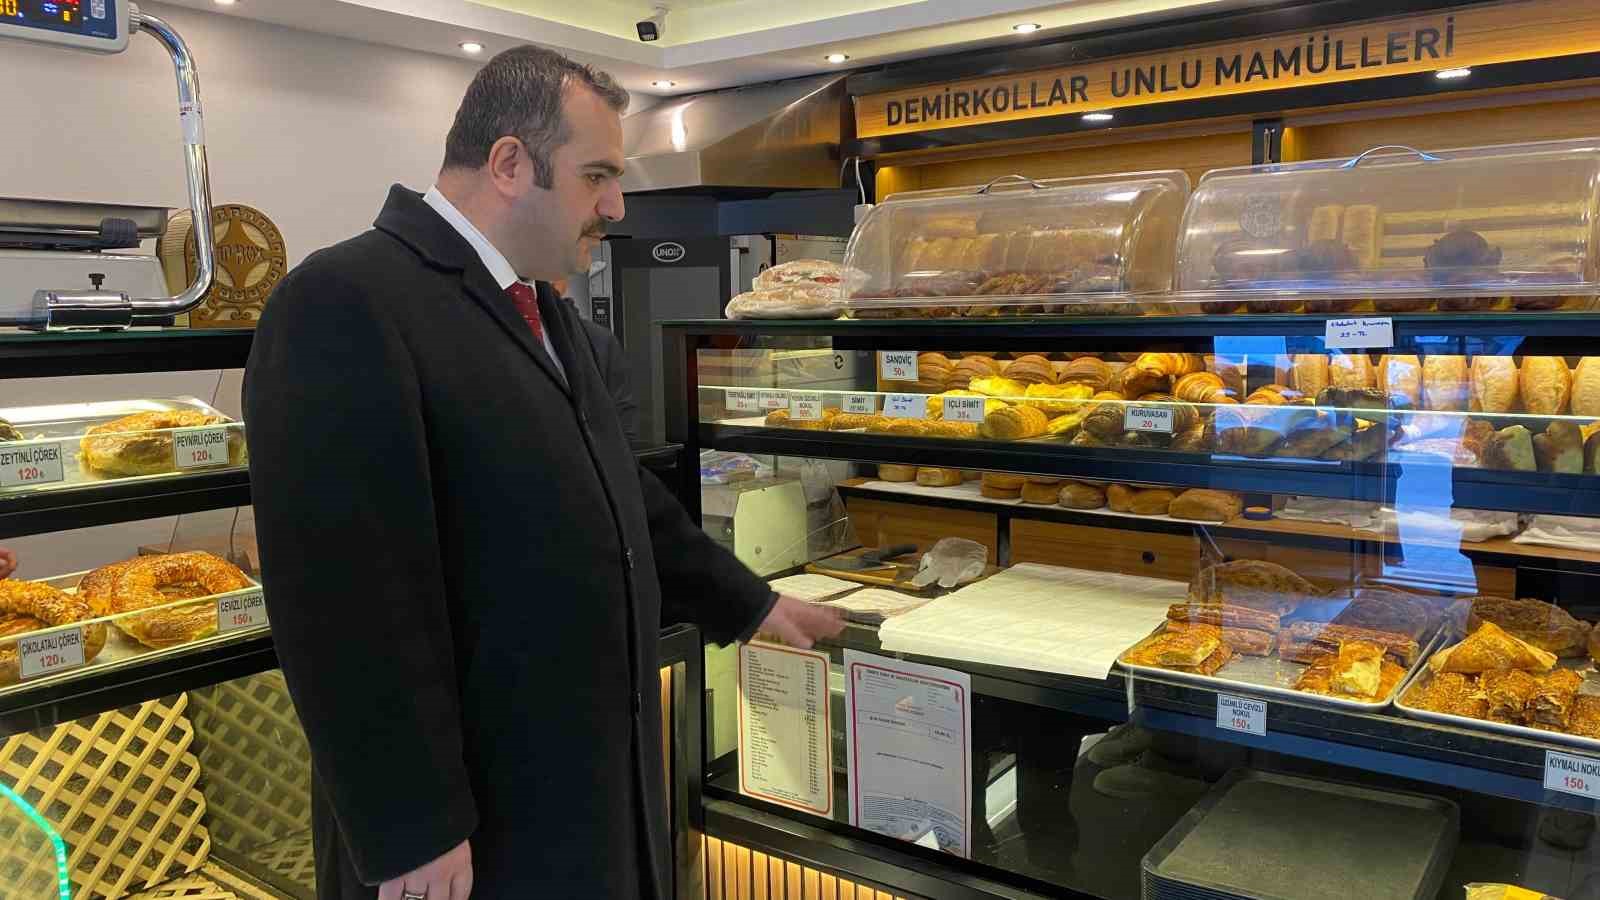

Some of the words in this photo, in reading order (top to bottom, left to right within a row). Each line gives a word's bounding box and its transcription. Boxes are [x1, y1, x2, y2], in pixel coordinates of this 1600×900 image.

[887, 75, 1089, 126] DEMİRKOLLAR
[1111, 59, 1201, 98] UNLU
[1215, 16, 1455, 86] MAMÜLLERİ
[1549, 757, 1580, 772] KIYMALI
